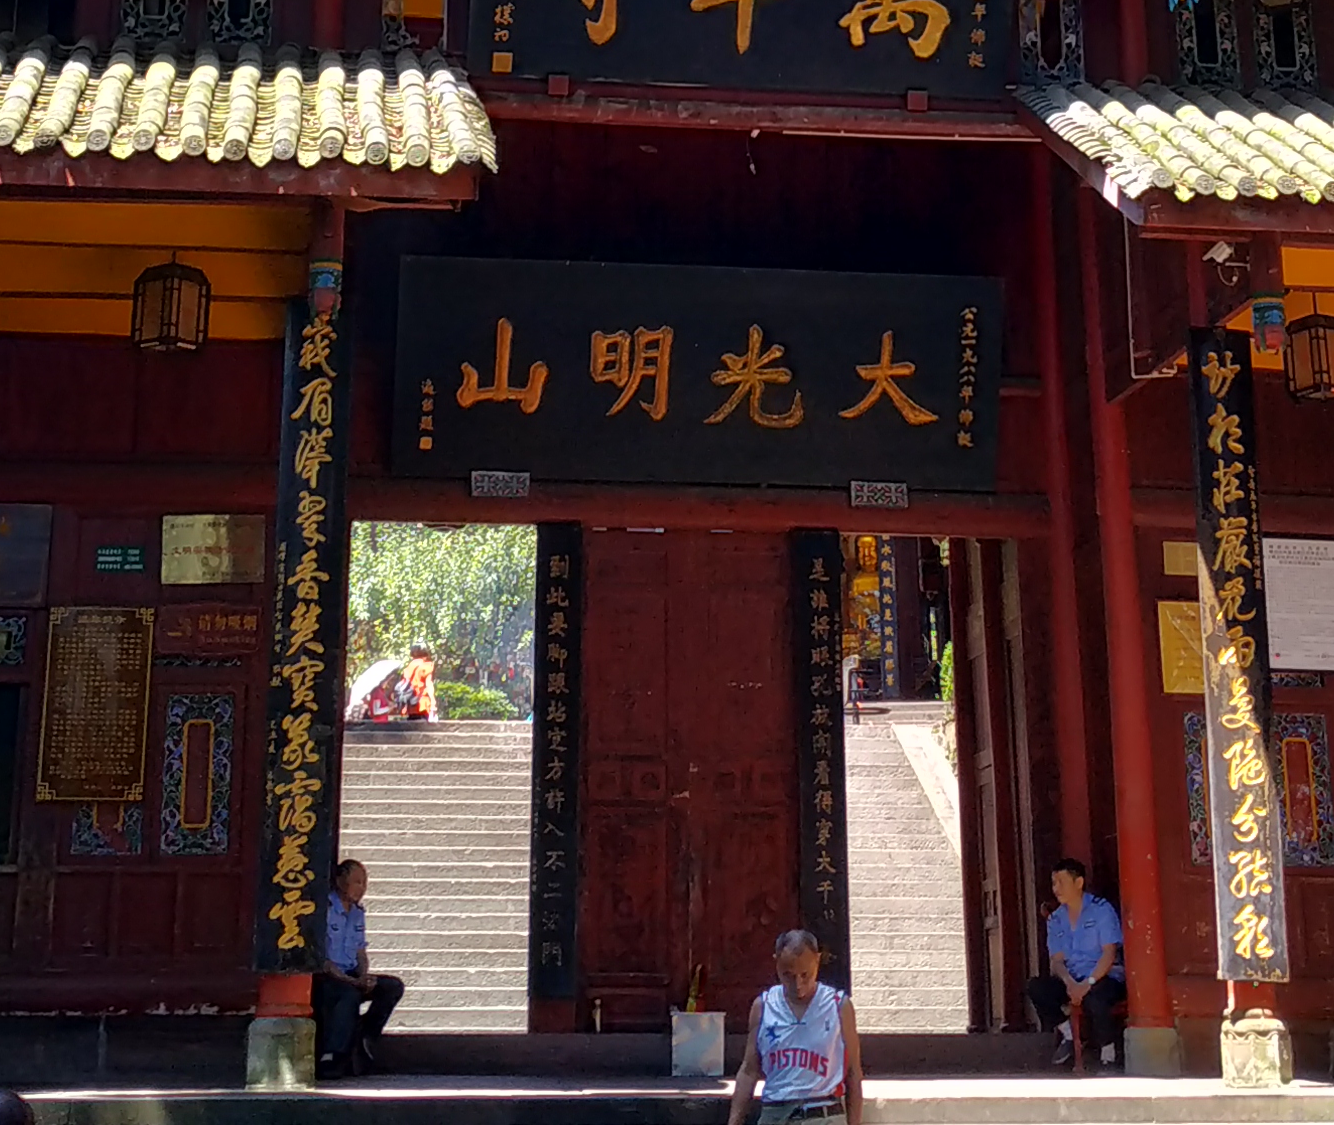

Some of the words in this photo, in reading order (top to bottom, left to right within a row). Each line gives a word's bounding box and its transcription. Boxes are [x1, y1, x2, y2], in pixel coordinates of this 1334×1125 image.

[456, 316, 940, 428] 大光明山
[768, 1047, 830, 1079] PISTONS
